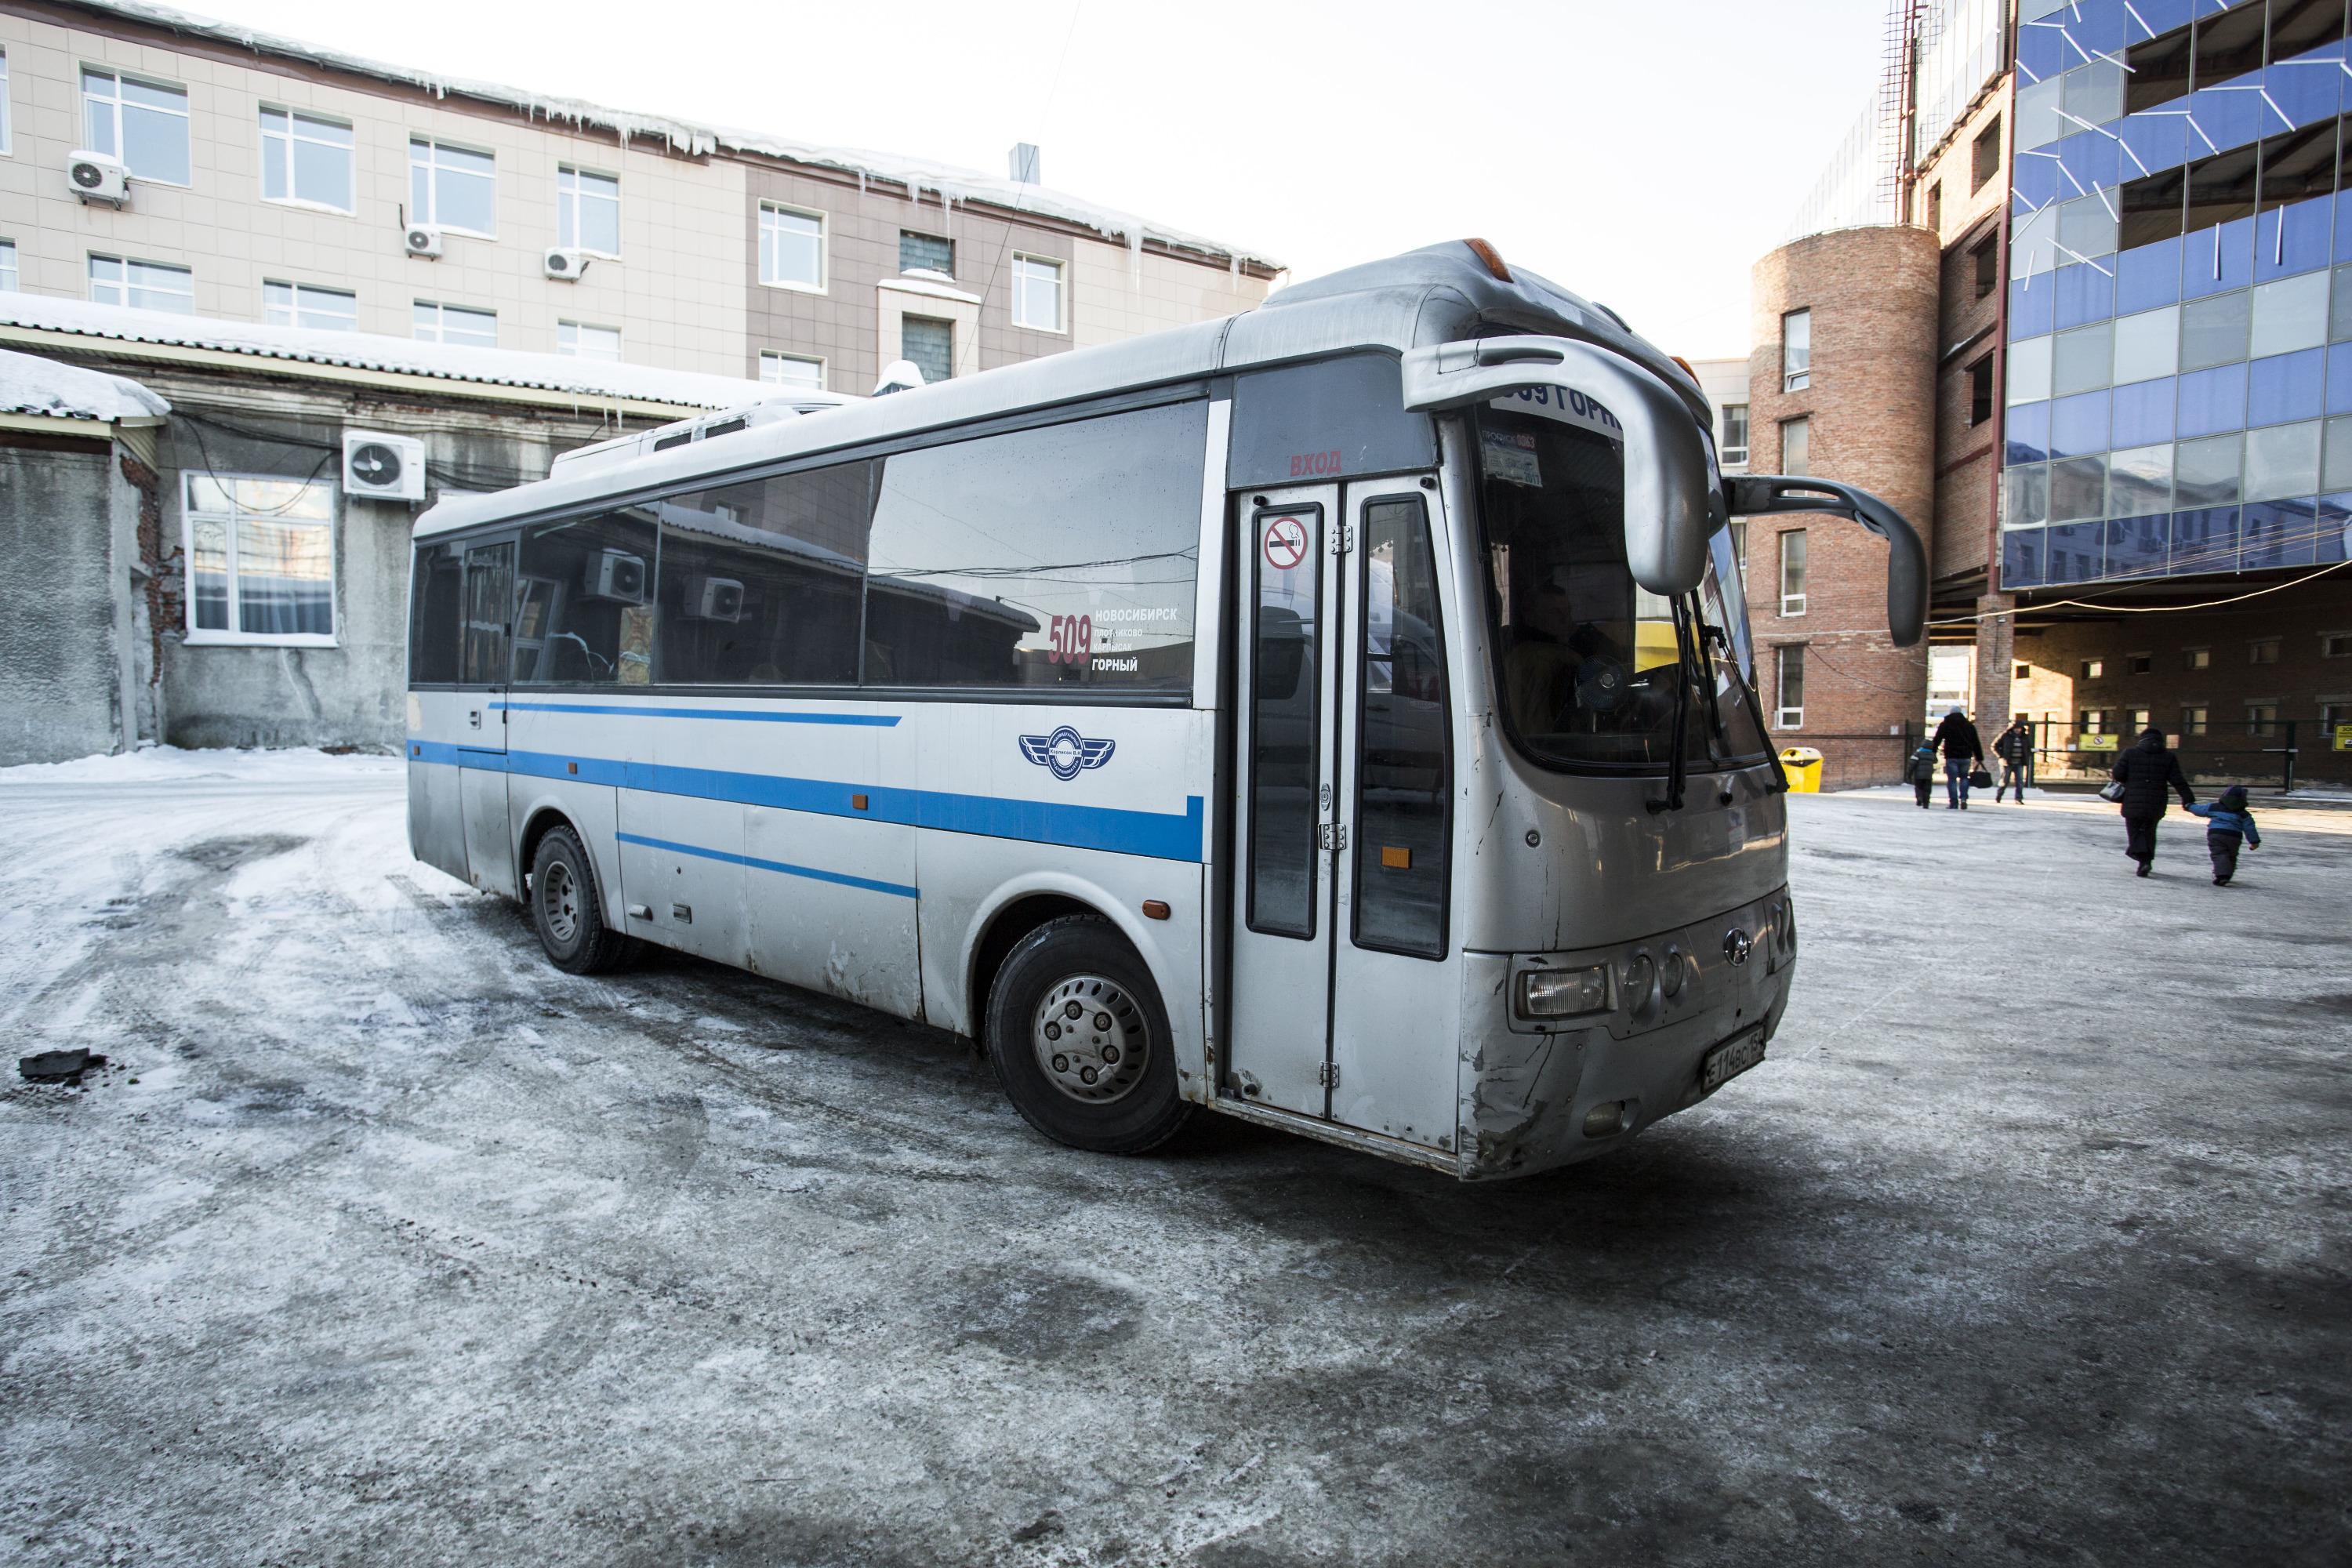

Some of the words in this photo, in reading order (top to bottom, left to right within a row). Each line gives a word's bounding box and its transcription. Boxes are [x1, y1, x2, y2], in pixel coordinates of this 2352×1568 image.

[1290, 451, 1343, 477] ВХОД
[1095, 608, 1178, 622] НОВОСИБИРСК
[1048, 615, 1092, 665] 509
[1094, 628, 1143, 638] ПЛОТНИКОВО
[1093, 642, 1132, 652] КАРПЫСАК
[1091, 656, 1138, 672] ГОРНЫЙ
